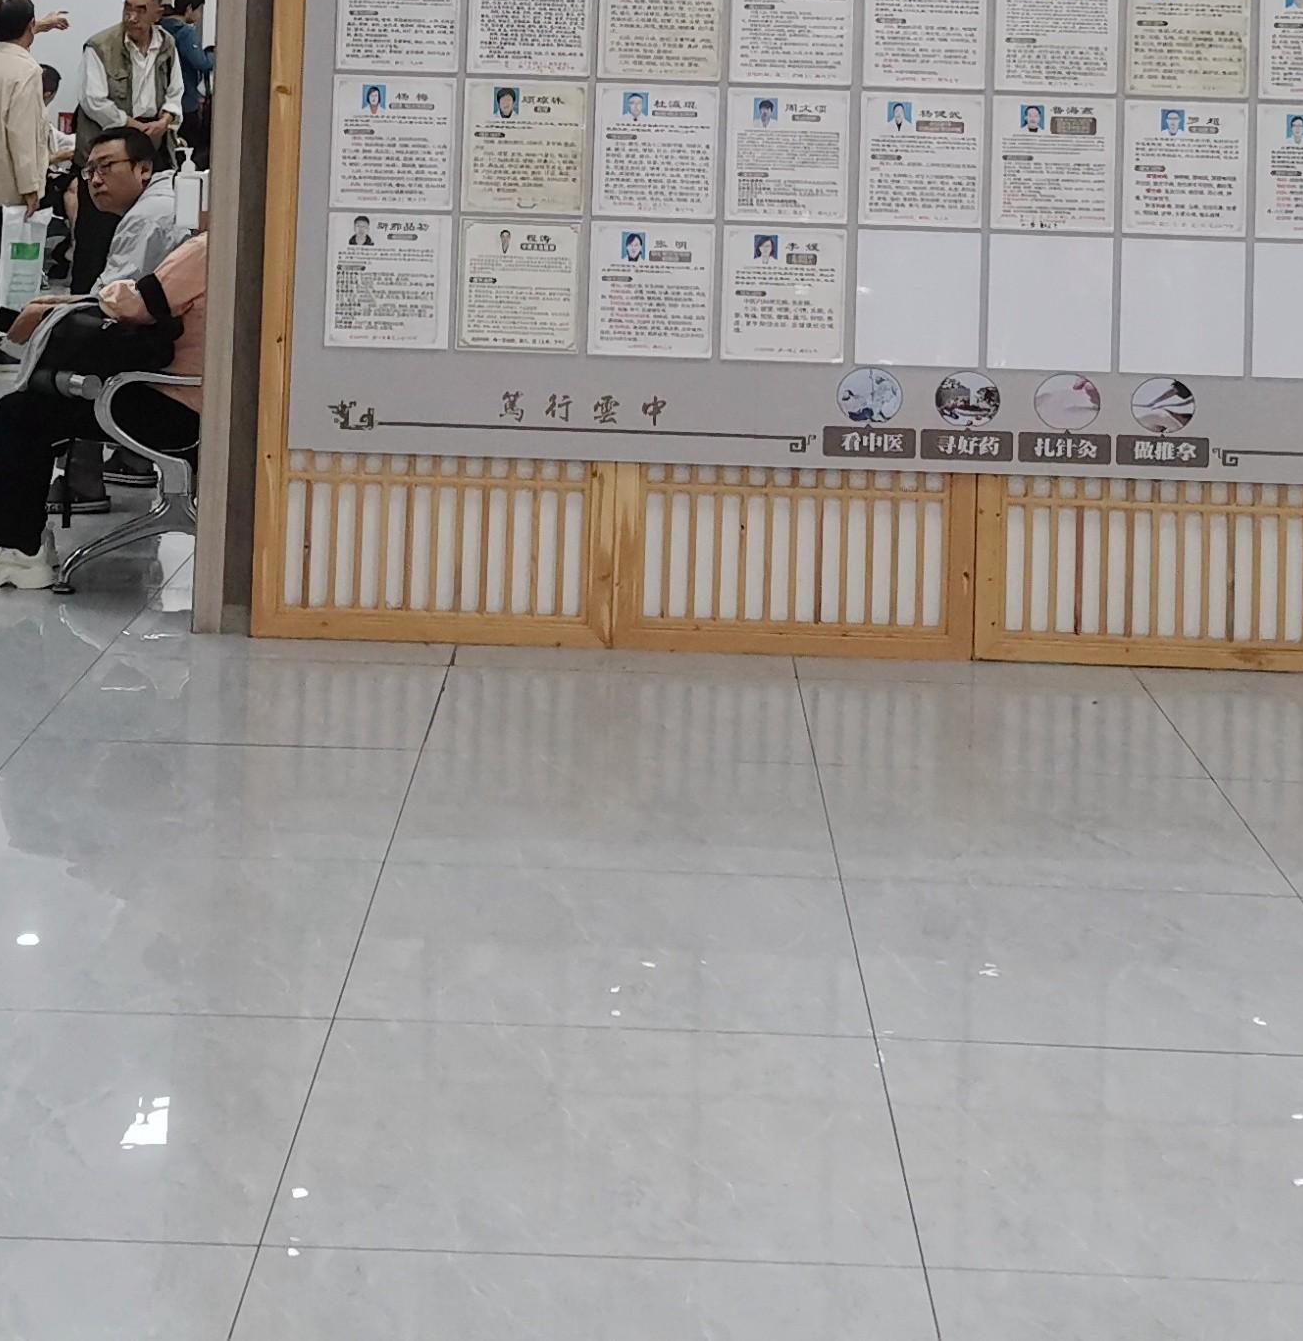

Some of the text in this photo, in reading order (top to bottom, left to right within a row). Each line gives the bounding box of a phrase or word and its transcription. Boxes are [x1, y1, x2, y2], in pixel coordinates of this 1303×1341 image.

[841, 431, 905, 453] 看中医
[936, 435, 1000, 456] 寻好药
[1034, 438, 1098, 460] 扎针灸
